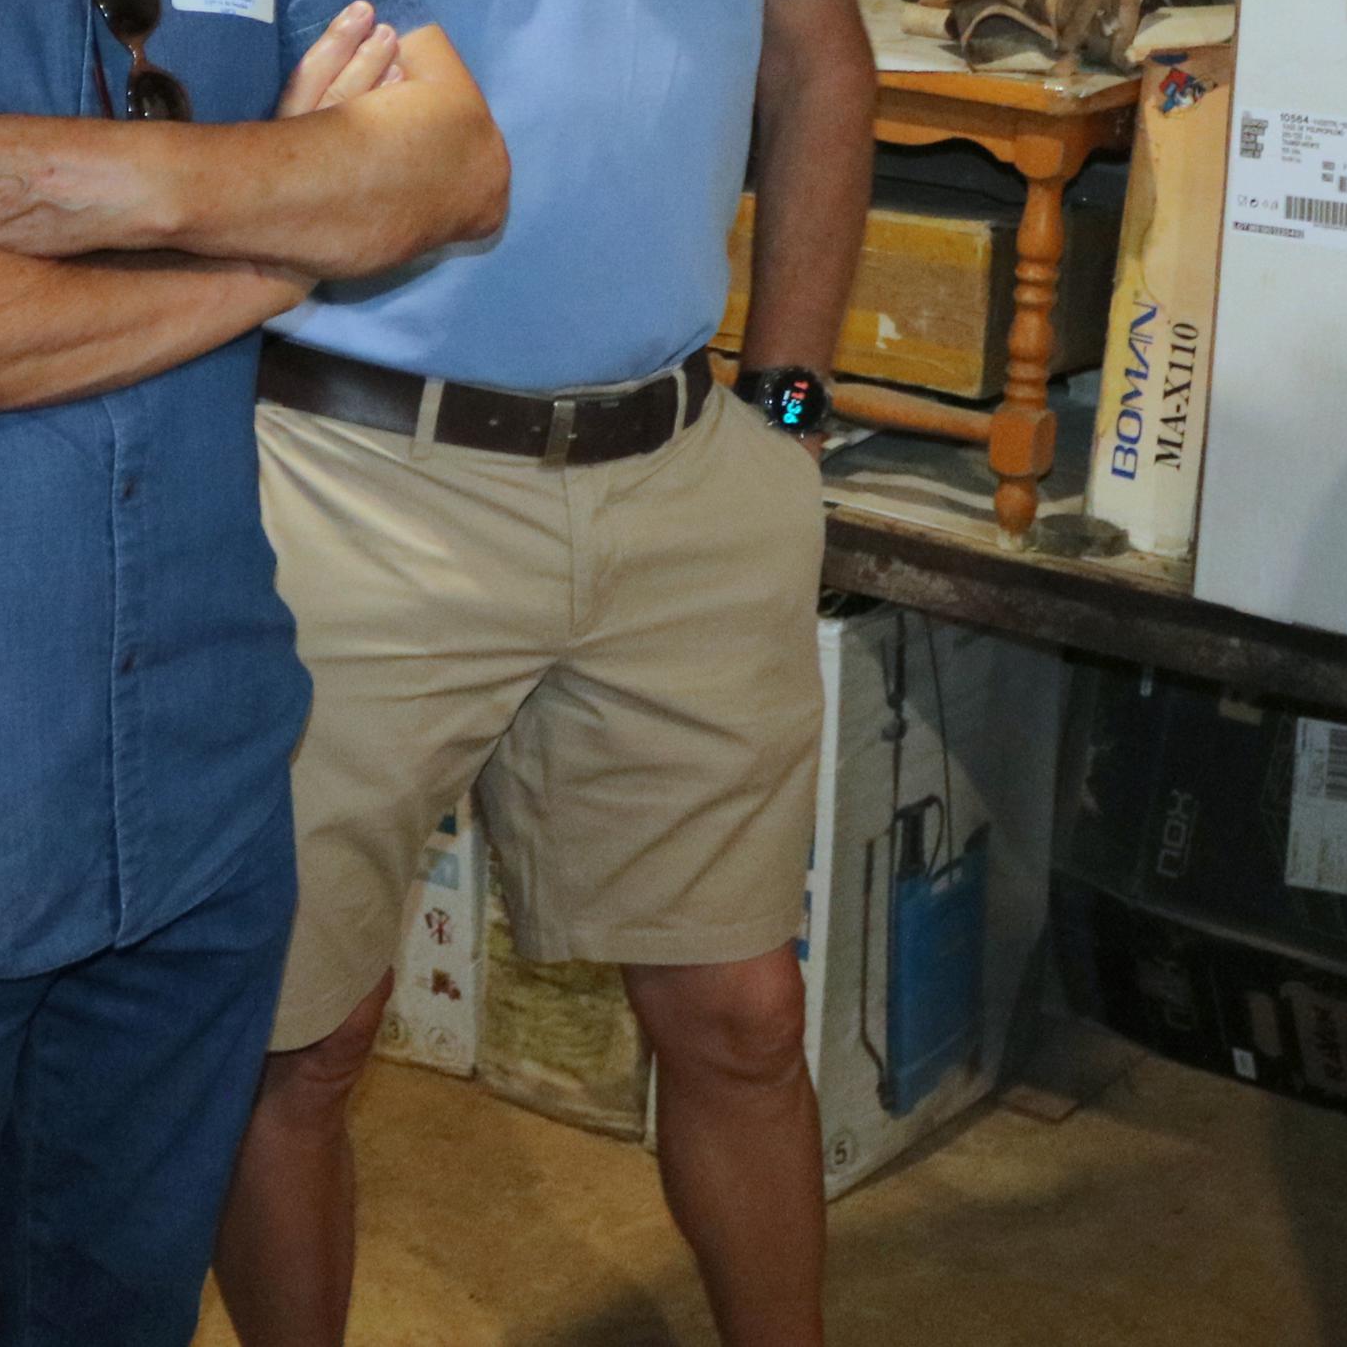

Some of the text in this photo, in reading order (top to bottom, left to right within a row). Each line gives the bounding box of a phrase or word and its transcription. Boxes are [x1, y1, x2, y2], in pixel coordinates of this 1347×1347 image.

[1110, 301, 1158, 481] BOMAN
[1154, 321, 1200, 470] MA-X110
[833, 1140, 848, 1165] 5
